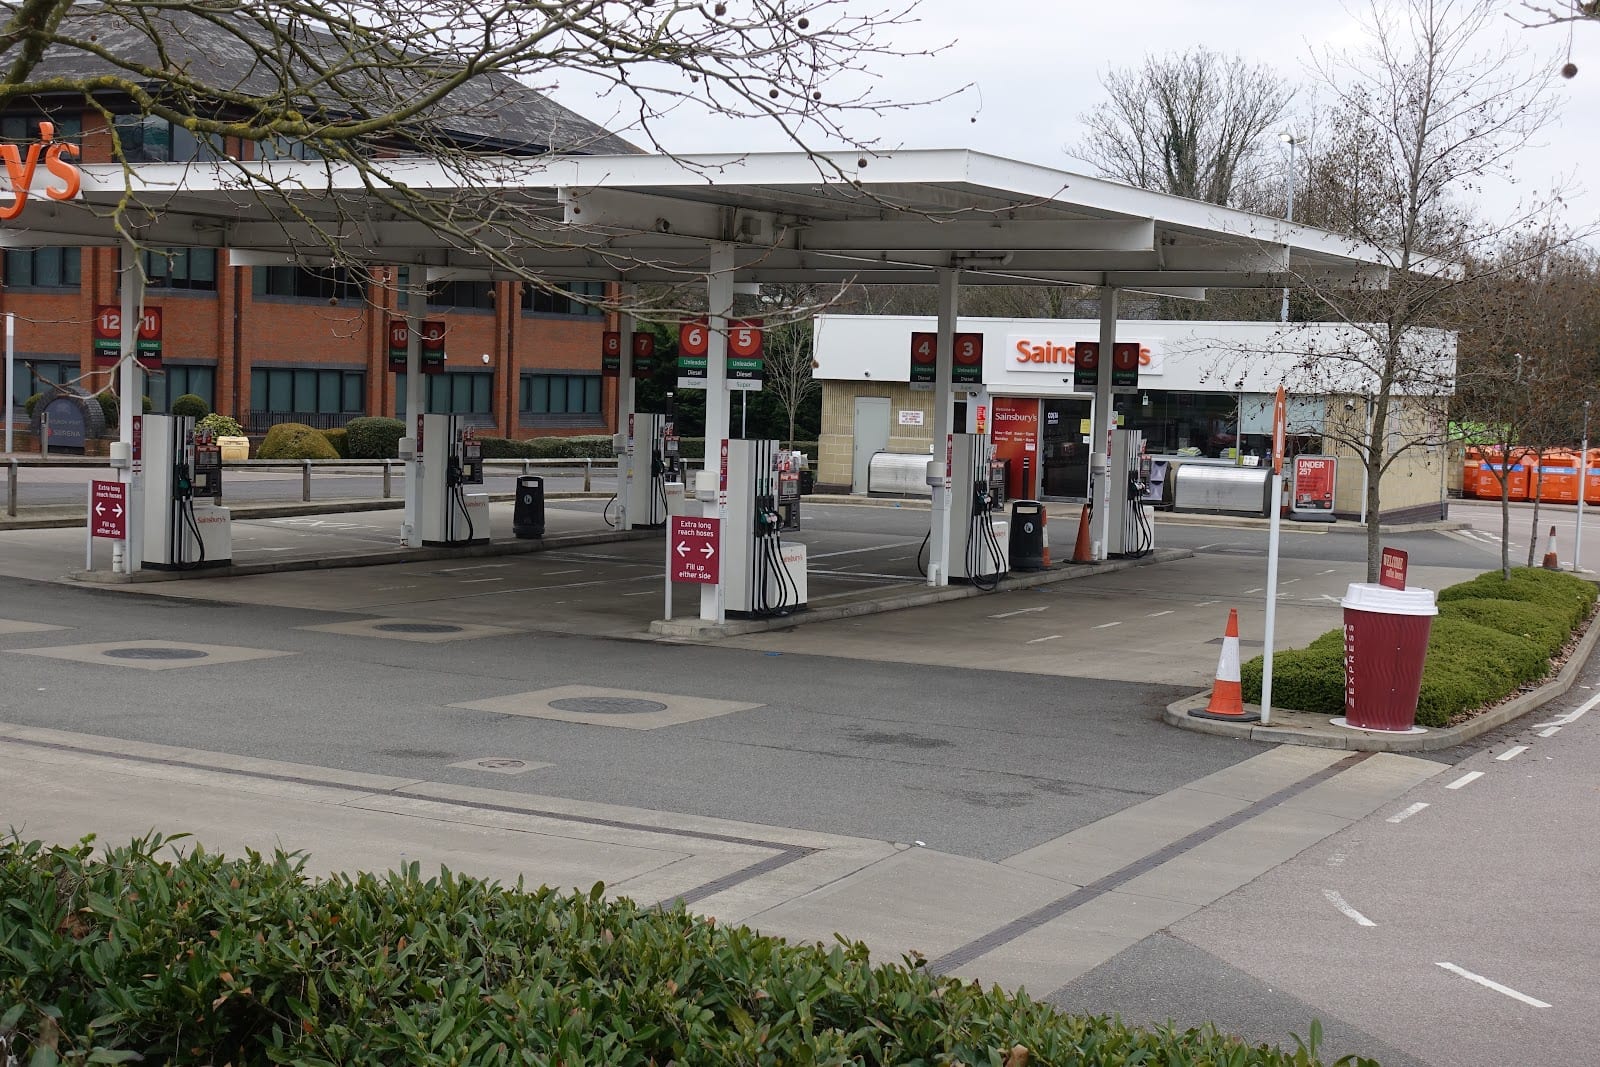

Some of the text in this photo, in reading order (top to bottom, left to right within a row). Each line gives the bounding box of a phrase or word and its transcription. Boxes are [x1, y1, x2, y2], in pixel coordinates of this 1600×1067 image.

[102, 314, 120, 330] 12
[145, 315, 155, 331] 11
[393, 329, 407, 341] 10
[689, 328, 702, 346] 6
[738, 329, 752, 347] 5
[608, 338, 618, 350] 8
[639, 339, 648, 351] 7
[918, 341, 930, 356] 4
[962, 341, 974, 357] 3
[1083, 349, 1093, 362] 2
[1121, 350, 1129, 363] 1
[732, 360, 757, 368] Unleaded
[994, 412, 1037, 423] Sainsbury's
[1299, 460, 1325, 469] UNDER
[680, 520, 712, 531] Extra long
[111, 528, 121, 536] side
[696, 530, 714, 538] hoses
[685, 562, 696, 570] Fill
[678, 571, 712, 580] either side
